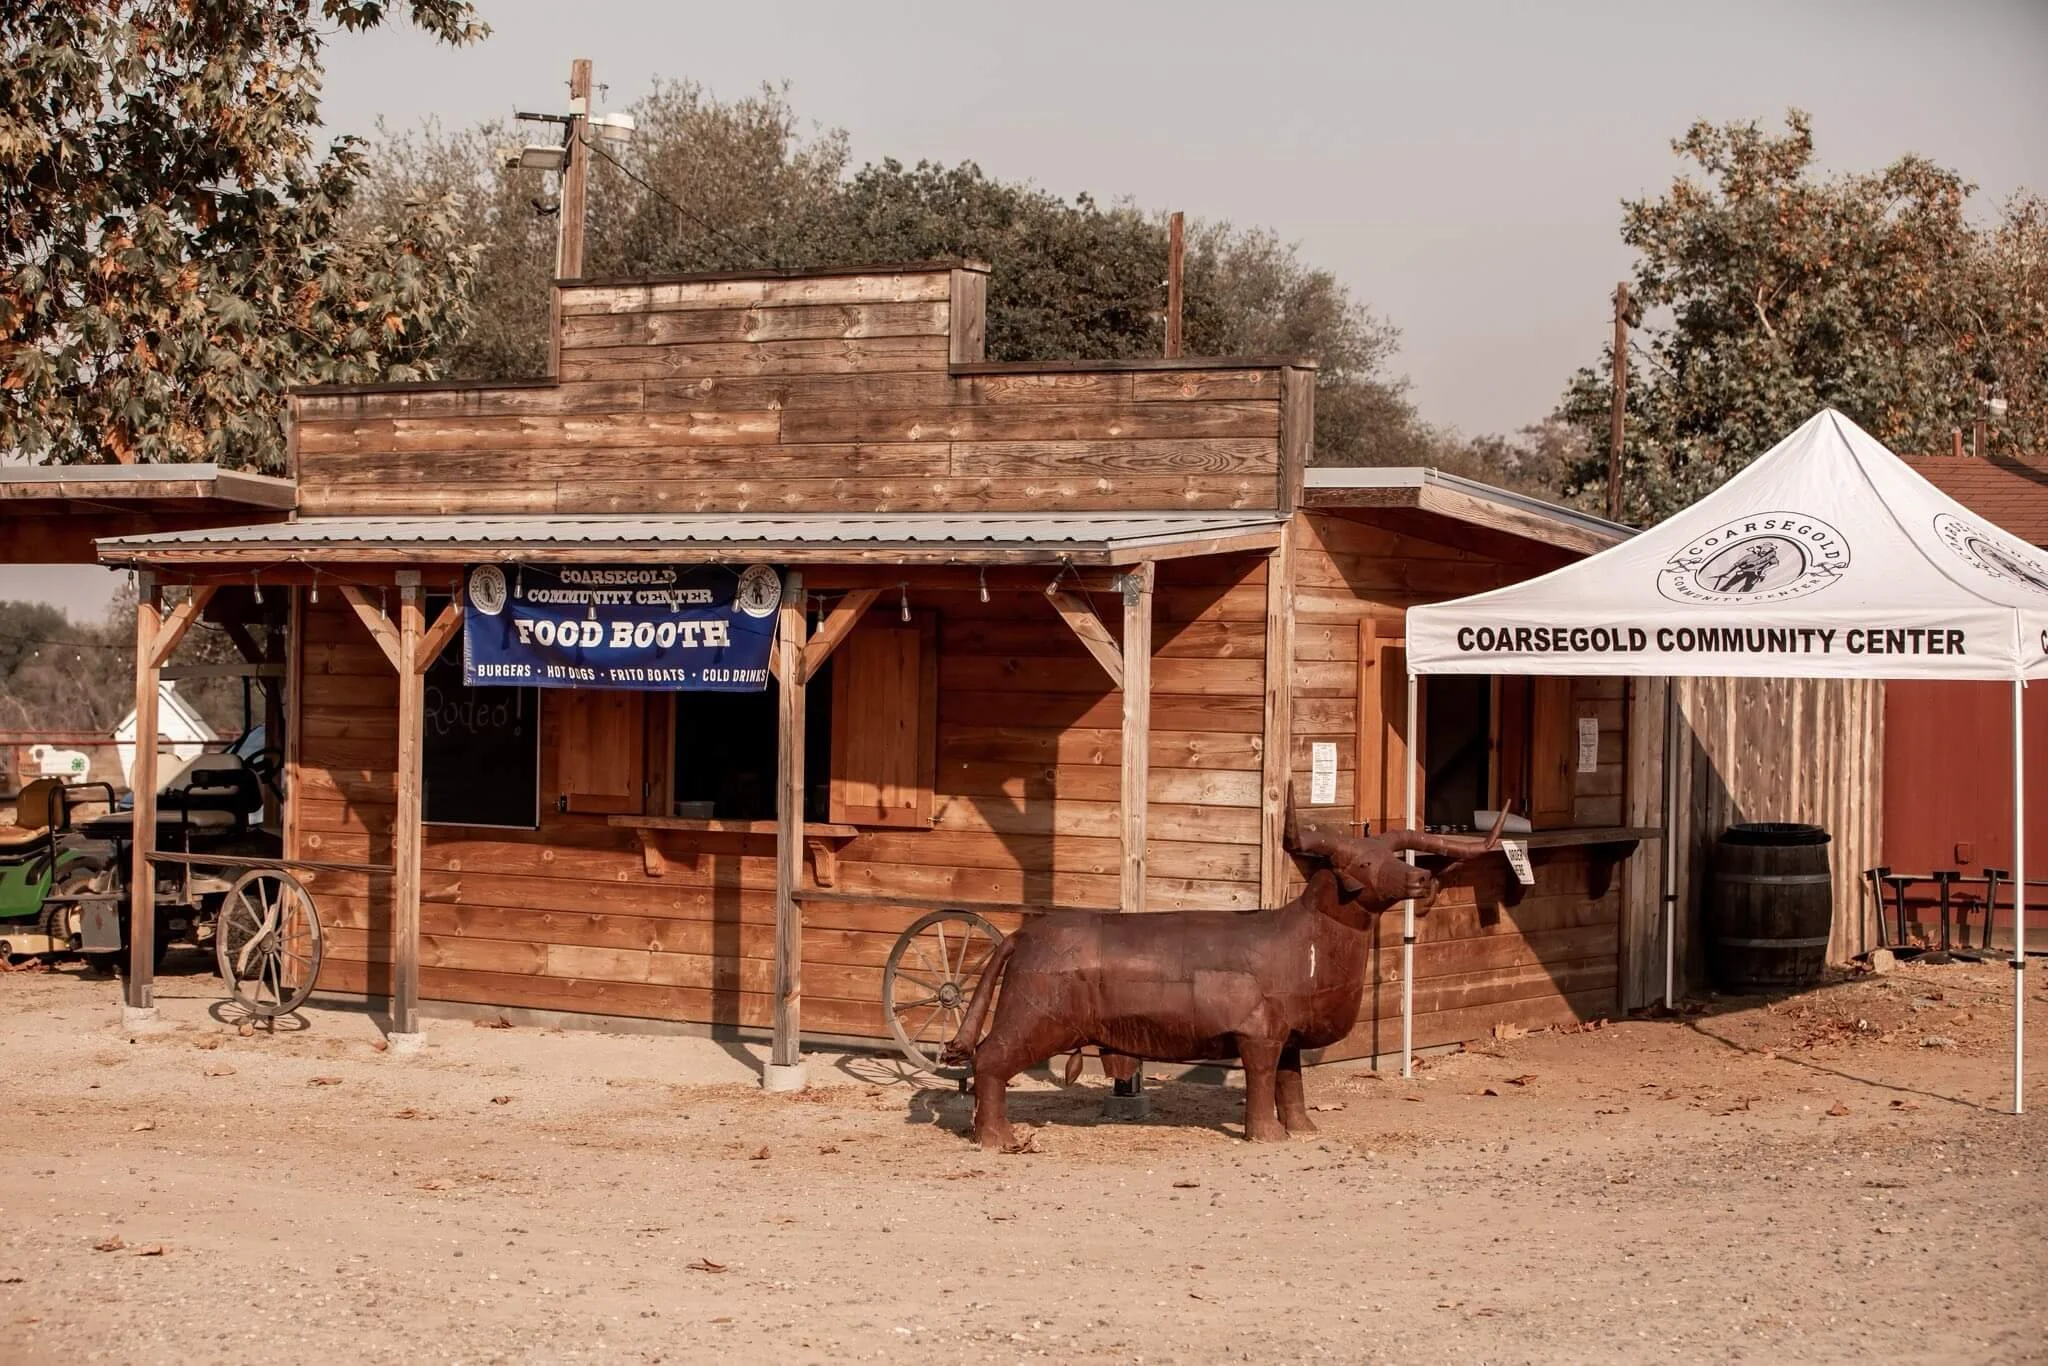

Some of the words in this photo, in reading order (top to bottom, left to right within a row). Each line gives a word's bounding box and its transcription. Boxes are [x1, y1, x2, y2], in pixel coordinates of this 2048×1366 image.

[1689, 519, 1840, 559] COARSEGOLD
[560, 569, 677, 585] COARSEGOLD
[1674, 575, 1743, 602] COMMUNITY
[1754, 579, 1822, 600] CENTER
[528, 589, 633, 605] COMMUNITY
[635, 588, 713, 604] CENTER
[514, 619, 603, 648] FOOD
[609, 620, 731, 648] BOOTH
[1457, 626, 1647, 652] COARSEGOLD
[1656, 627, 1836, 653] COMMUNITY
[1846, 629, 1966, 655] CENTER
[478, 664, 531, 678] BURGERS
[547, 666, 567, 679] HOT
[568, 667, 596, 681] DOGS
[610, 668, 644, 681] FRITO
[647, 668, 685, 681] BOATS
[702, 668, 730, 682] COLD
[732, 668, 766, 682] DRINKS
